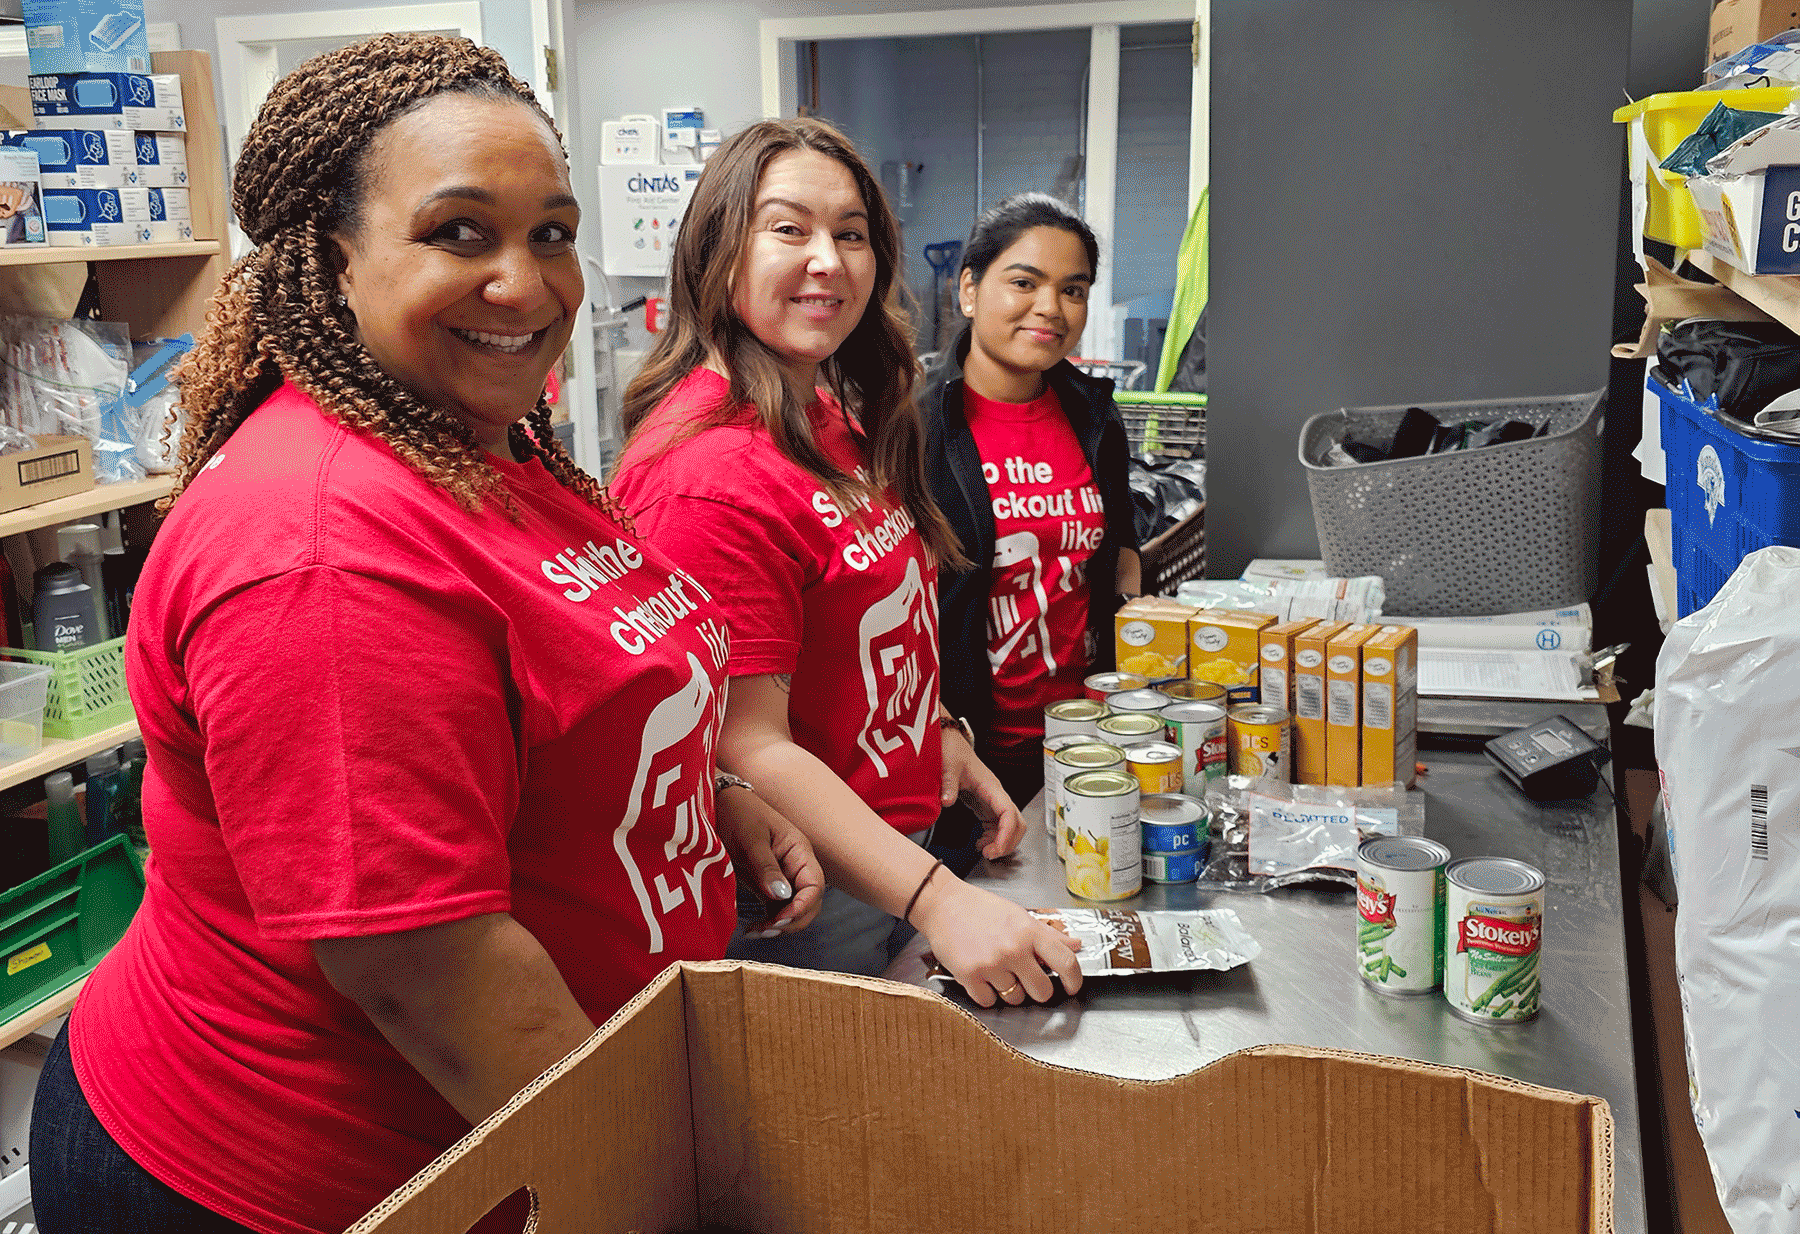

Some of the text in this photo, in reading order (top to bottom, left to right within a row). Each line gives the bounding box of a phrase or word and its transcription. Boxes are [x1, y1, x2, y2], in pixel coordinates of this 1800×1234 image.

[628, 172, 680, 193] CINTAS
[1005, 456, 1053, 484] the
[992, 488, 1076, 520] ckout
[842, 505, 917, 571] checkou
[1060, 520, 1105, 552] like
[55, 624, 84, 637] Dove
[1173, 833, 1189, 849] pc
[1116, 921, 1136, 962] Stew
